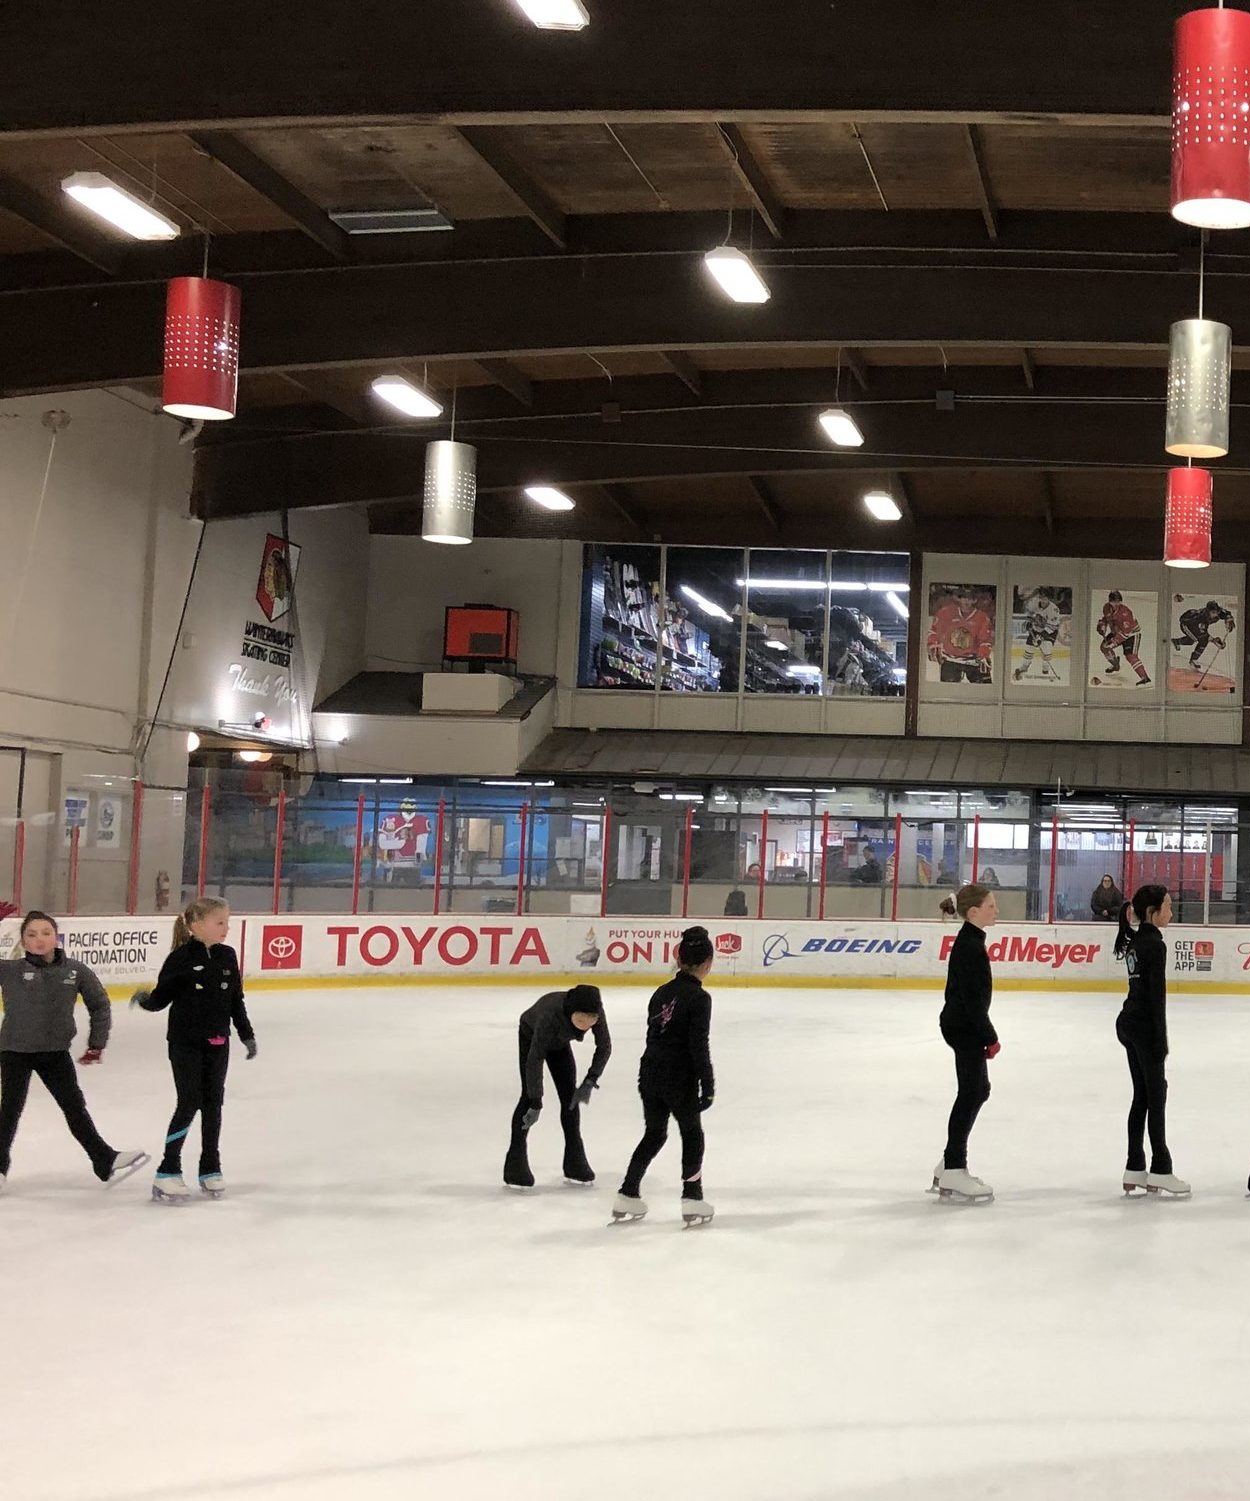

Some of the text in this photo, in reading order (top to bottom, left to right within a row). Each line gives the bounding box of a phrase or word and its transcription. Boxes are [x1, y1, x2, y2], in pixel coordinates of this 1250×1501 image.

[228, 663, 298, 707] Thank You
[68, 930, 158, 949] PACIFIC OFFICE
[609, 930, 629, 939] PUT
[631, 930, 661, 939] YOUR
[327, 925, 551, 967] TOYOTA
[605, 941, 651, 963] ON
[801, 938, 922, 954] BOEING
[938, 934, 1101, 969] FdMeyer
[1175, 941, 1194, 950] GET
[69, 948, 147, 966] AUTOMATION
[1175, 951, 1194, 961] THE
[1175, 961, 1195, 971] APP
